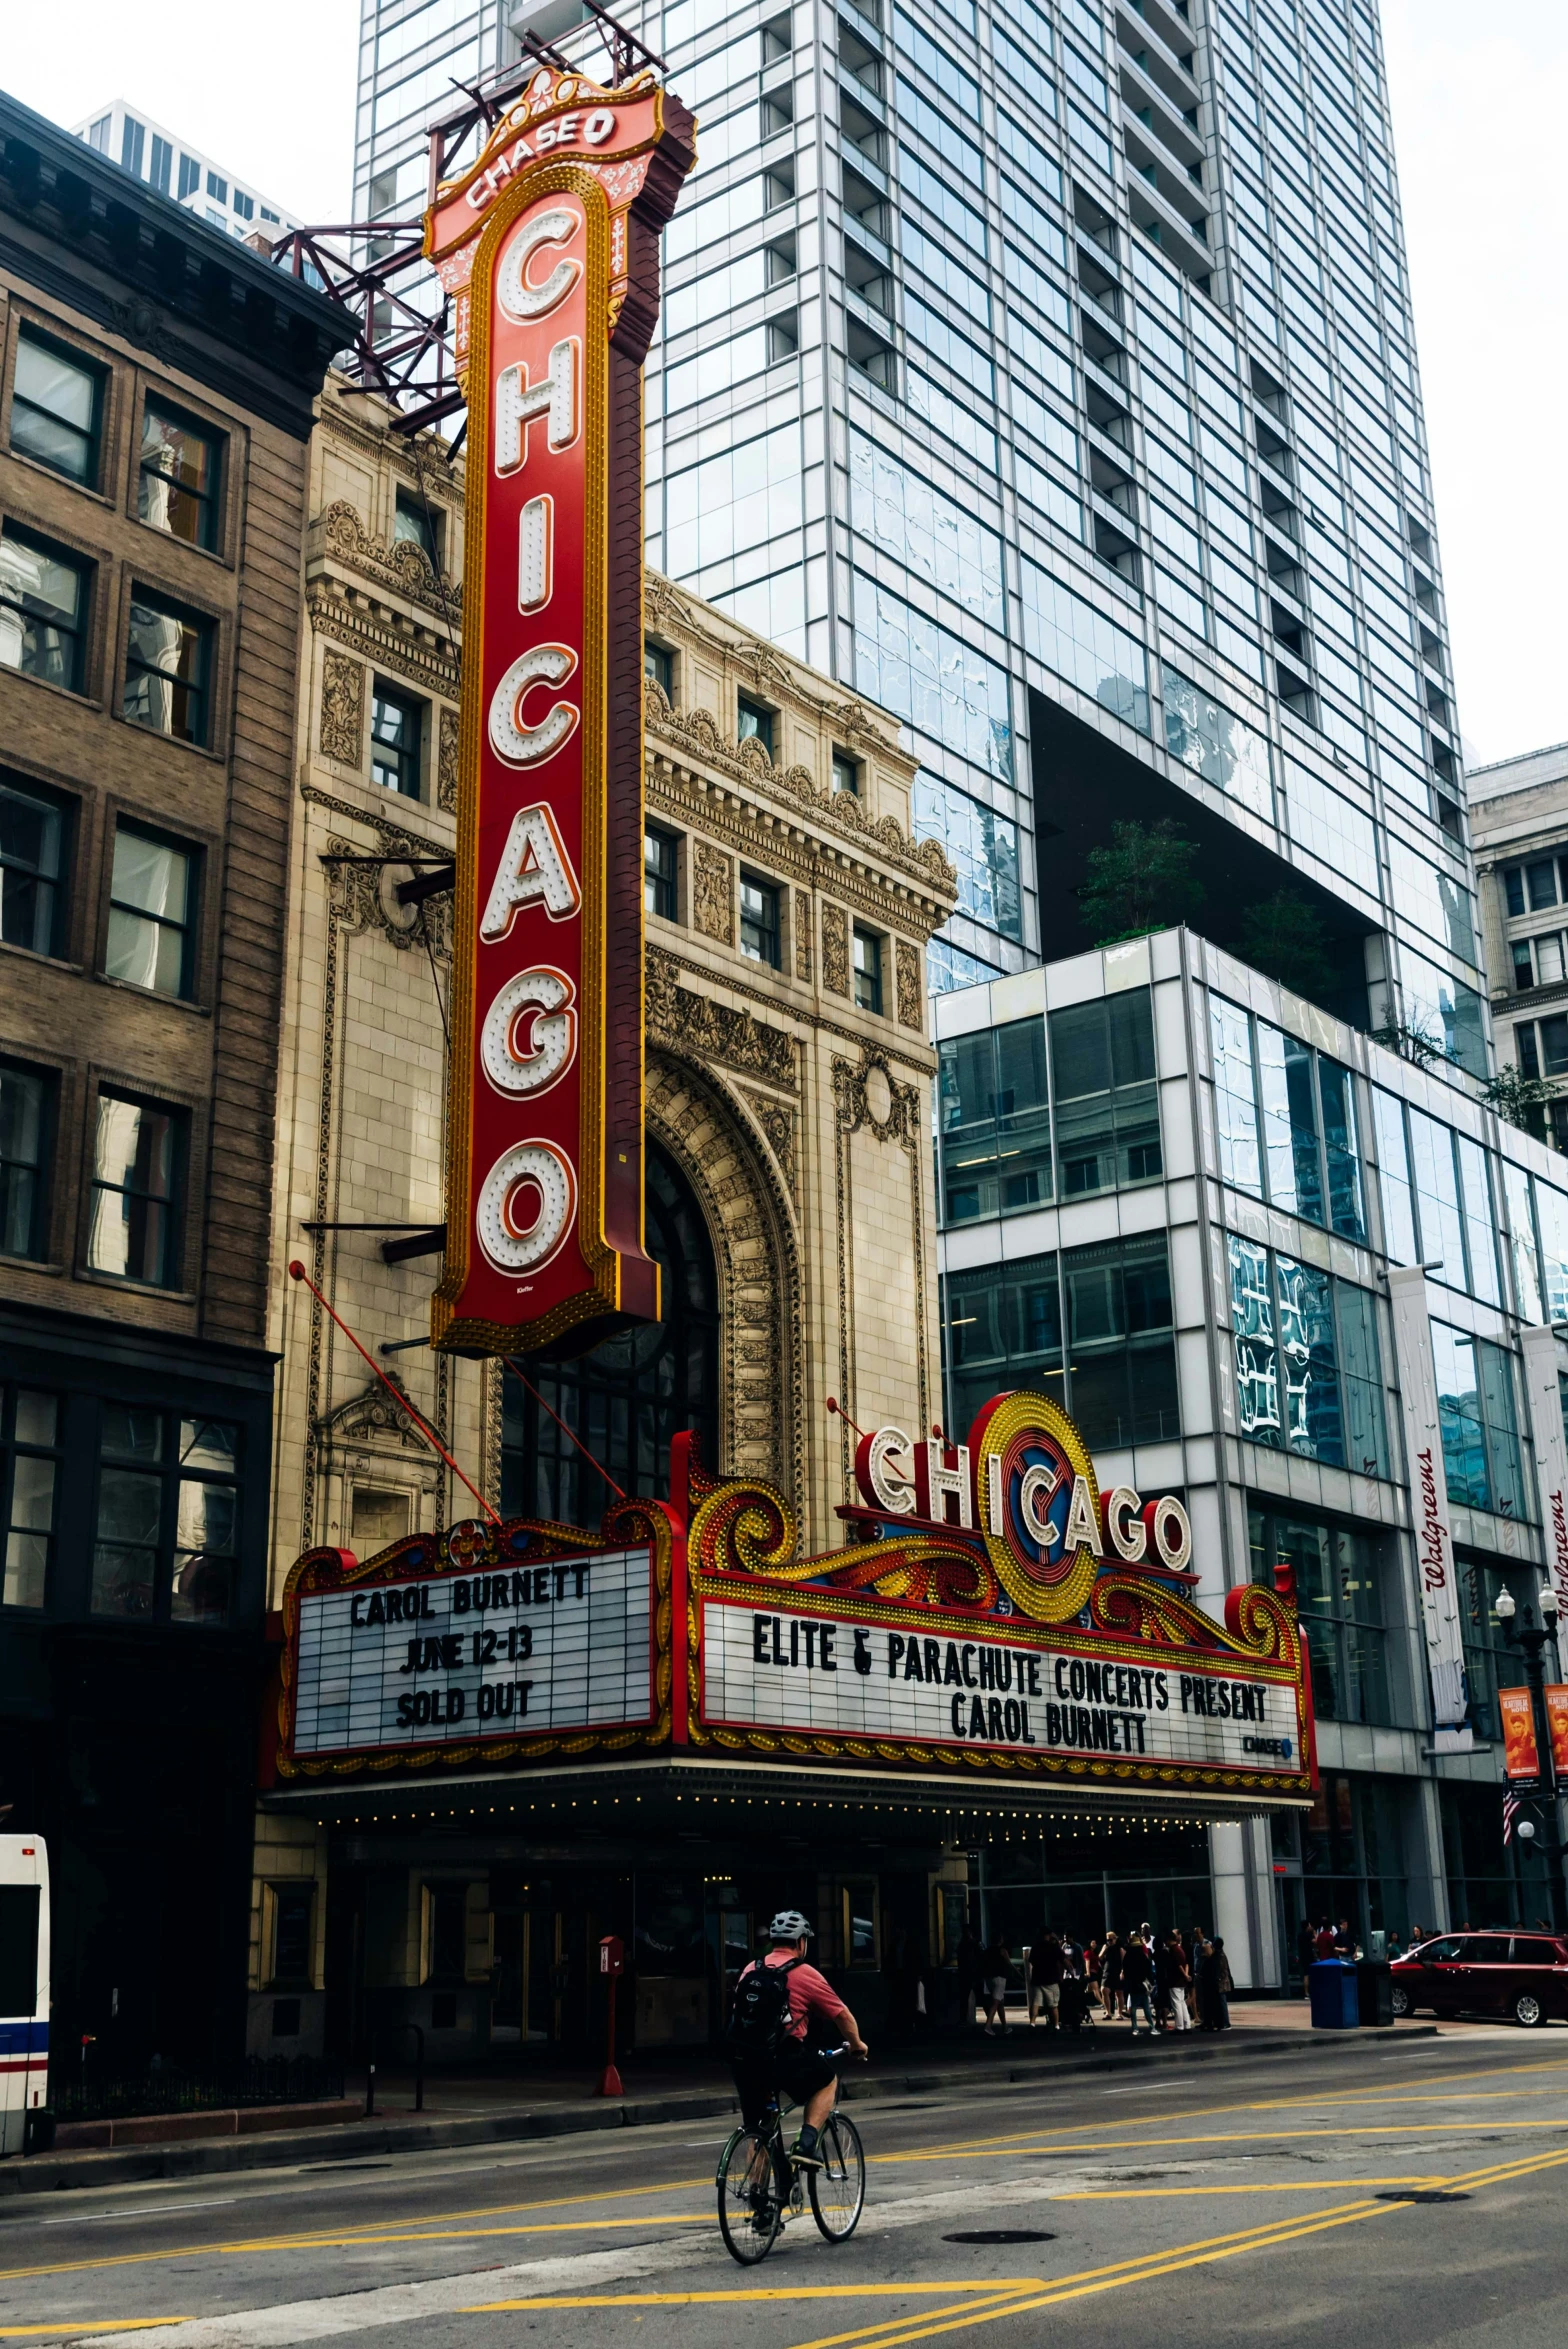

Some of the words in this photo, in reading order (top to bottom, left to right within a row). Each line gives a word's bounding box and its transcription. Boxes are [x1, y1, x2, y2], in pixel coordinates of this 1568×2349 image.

[465, 113, 582, 209] CHASE
[476, 207, 586, 1277] CHICAGO
[856, 1425, 1192, 1572] CHICAGO
[1417, 1447, 1448, 1593] Walgreens
[350, 1584, 435, 1627] CAROL
[453, 1562, 590, 1615] BURNETT
[400, 1632, 464, 1674] JUNE
[472, 1624, 533, 1666] 12-13
[753, 1613, 837, 1671] ELITE
[853, 1628, 872, 1675] &
[888, 1632, 1042, 1696] PARACHUTE
[1054, 1657, 1170, 1711] CONCERTS
[1180, 1673, 1267, 1722] PRESENT
[396, 1687, 465, 1728] SOLD
[476, 1680, 534, 1720] OUT
[951, 1692, 1036, 1744] CAROL
[1046, 1701, 1147, 1753] BURNETT
[1511, 1705, 1529, 1713] HOTEL
[1243, 1736, 1282, 1755] CHASE
